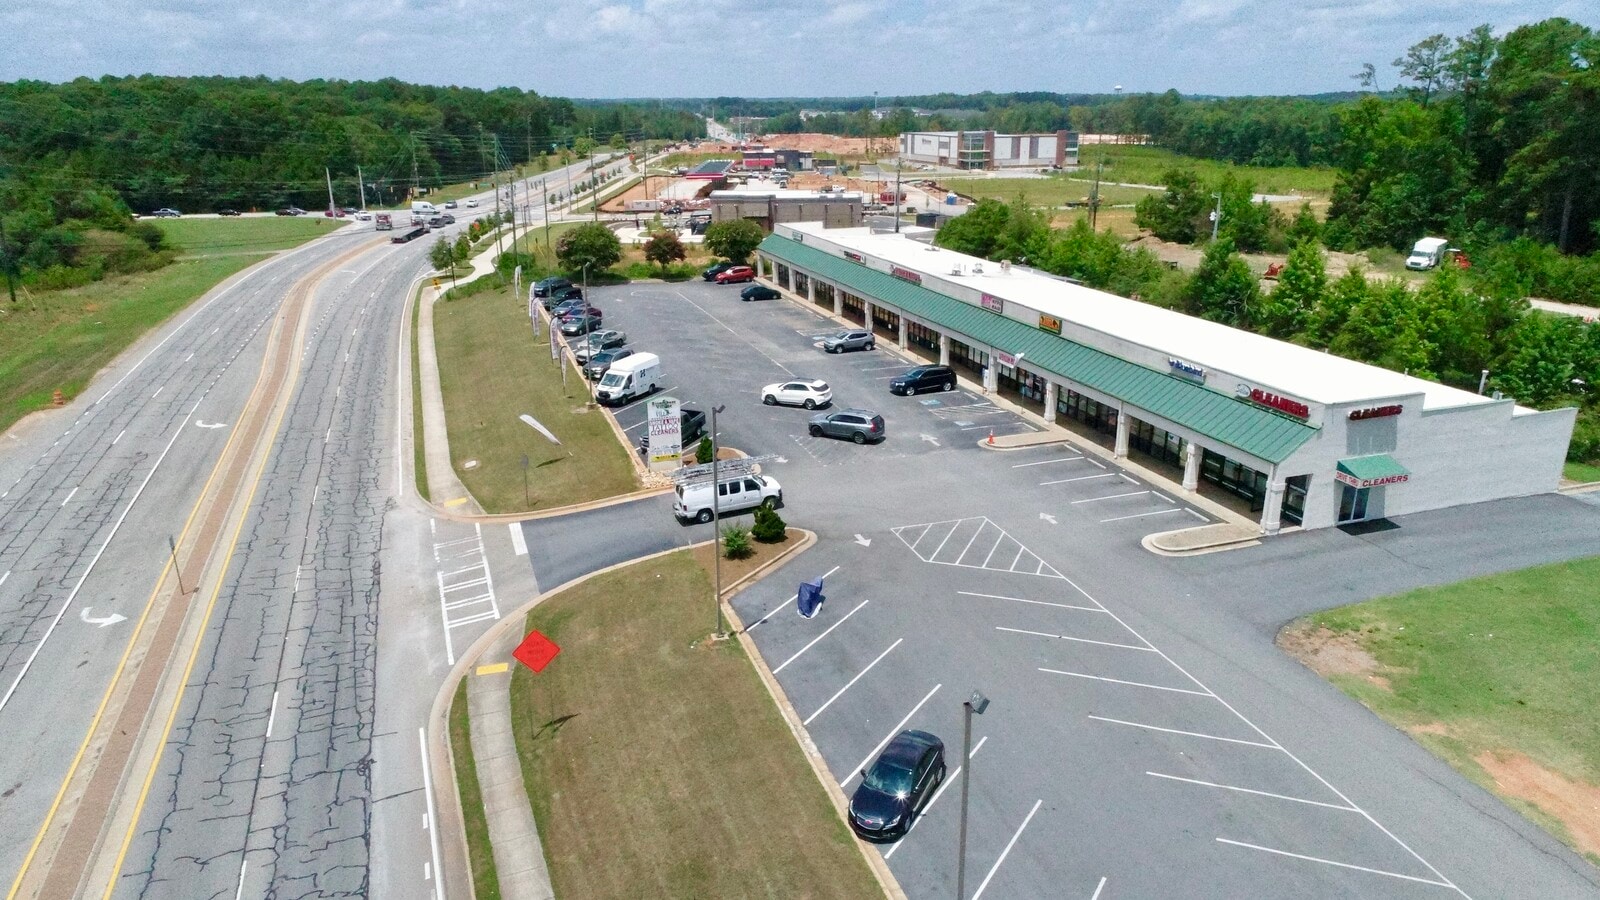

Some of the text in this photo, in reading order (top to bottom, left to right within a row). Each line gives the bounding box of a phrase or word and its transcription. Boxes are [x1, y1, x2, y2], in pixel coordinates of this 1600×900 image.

[1251, 388, 1309, 418] CLEANERS
[1349, 404, 1403, 421] CLEANERS
[1362, 475, 1408, 487] CLEANERS
